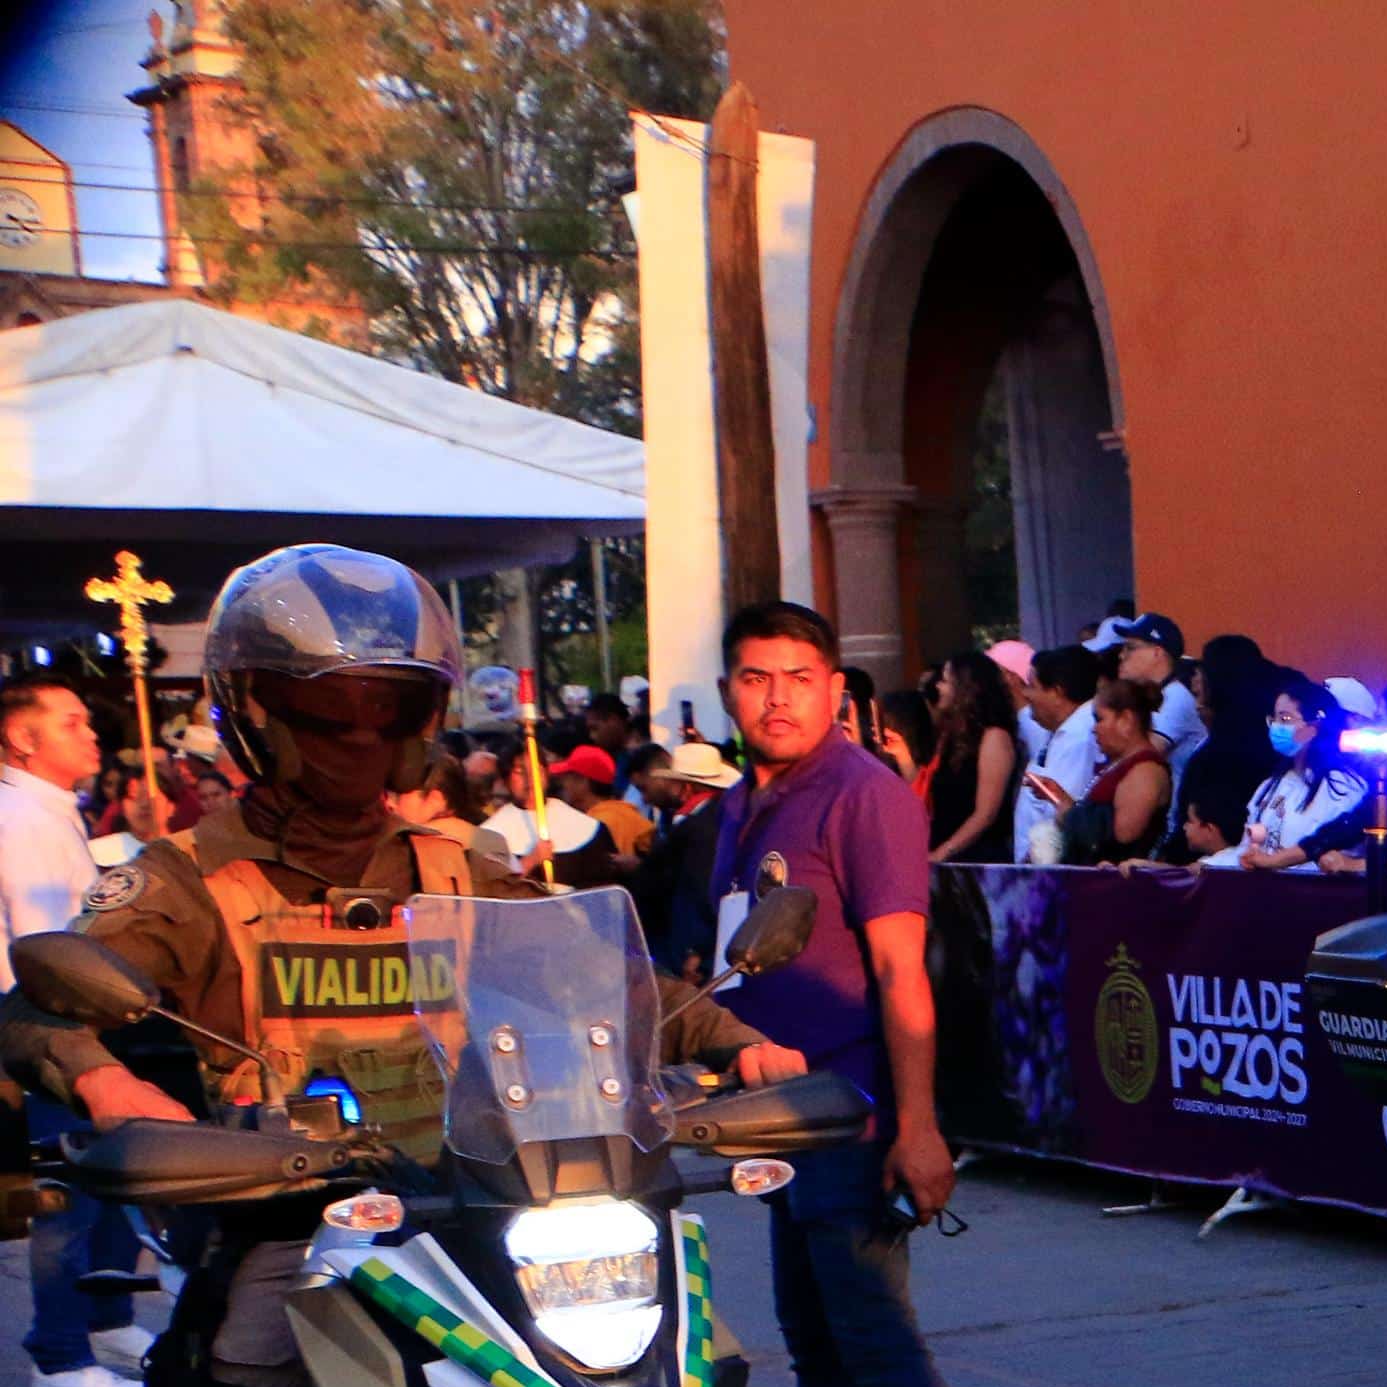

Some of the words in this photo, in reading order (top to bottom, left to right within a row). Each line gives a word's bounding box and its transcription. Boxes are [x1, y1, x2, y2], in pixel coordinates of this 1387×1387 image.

[272, 953, 456, 1007] VIALIDAD
[1166, 972, 1259, 1029] VILLA
[1258, 979, 1304, 1034] DE
[1168, 1026, 1308, 1105] POZOS
